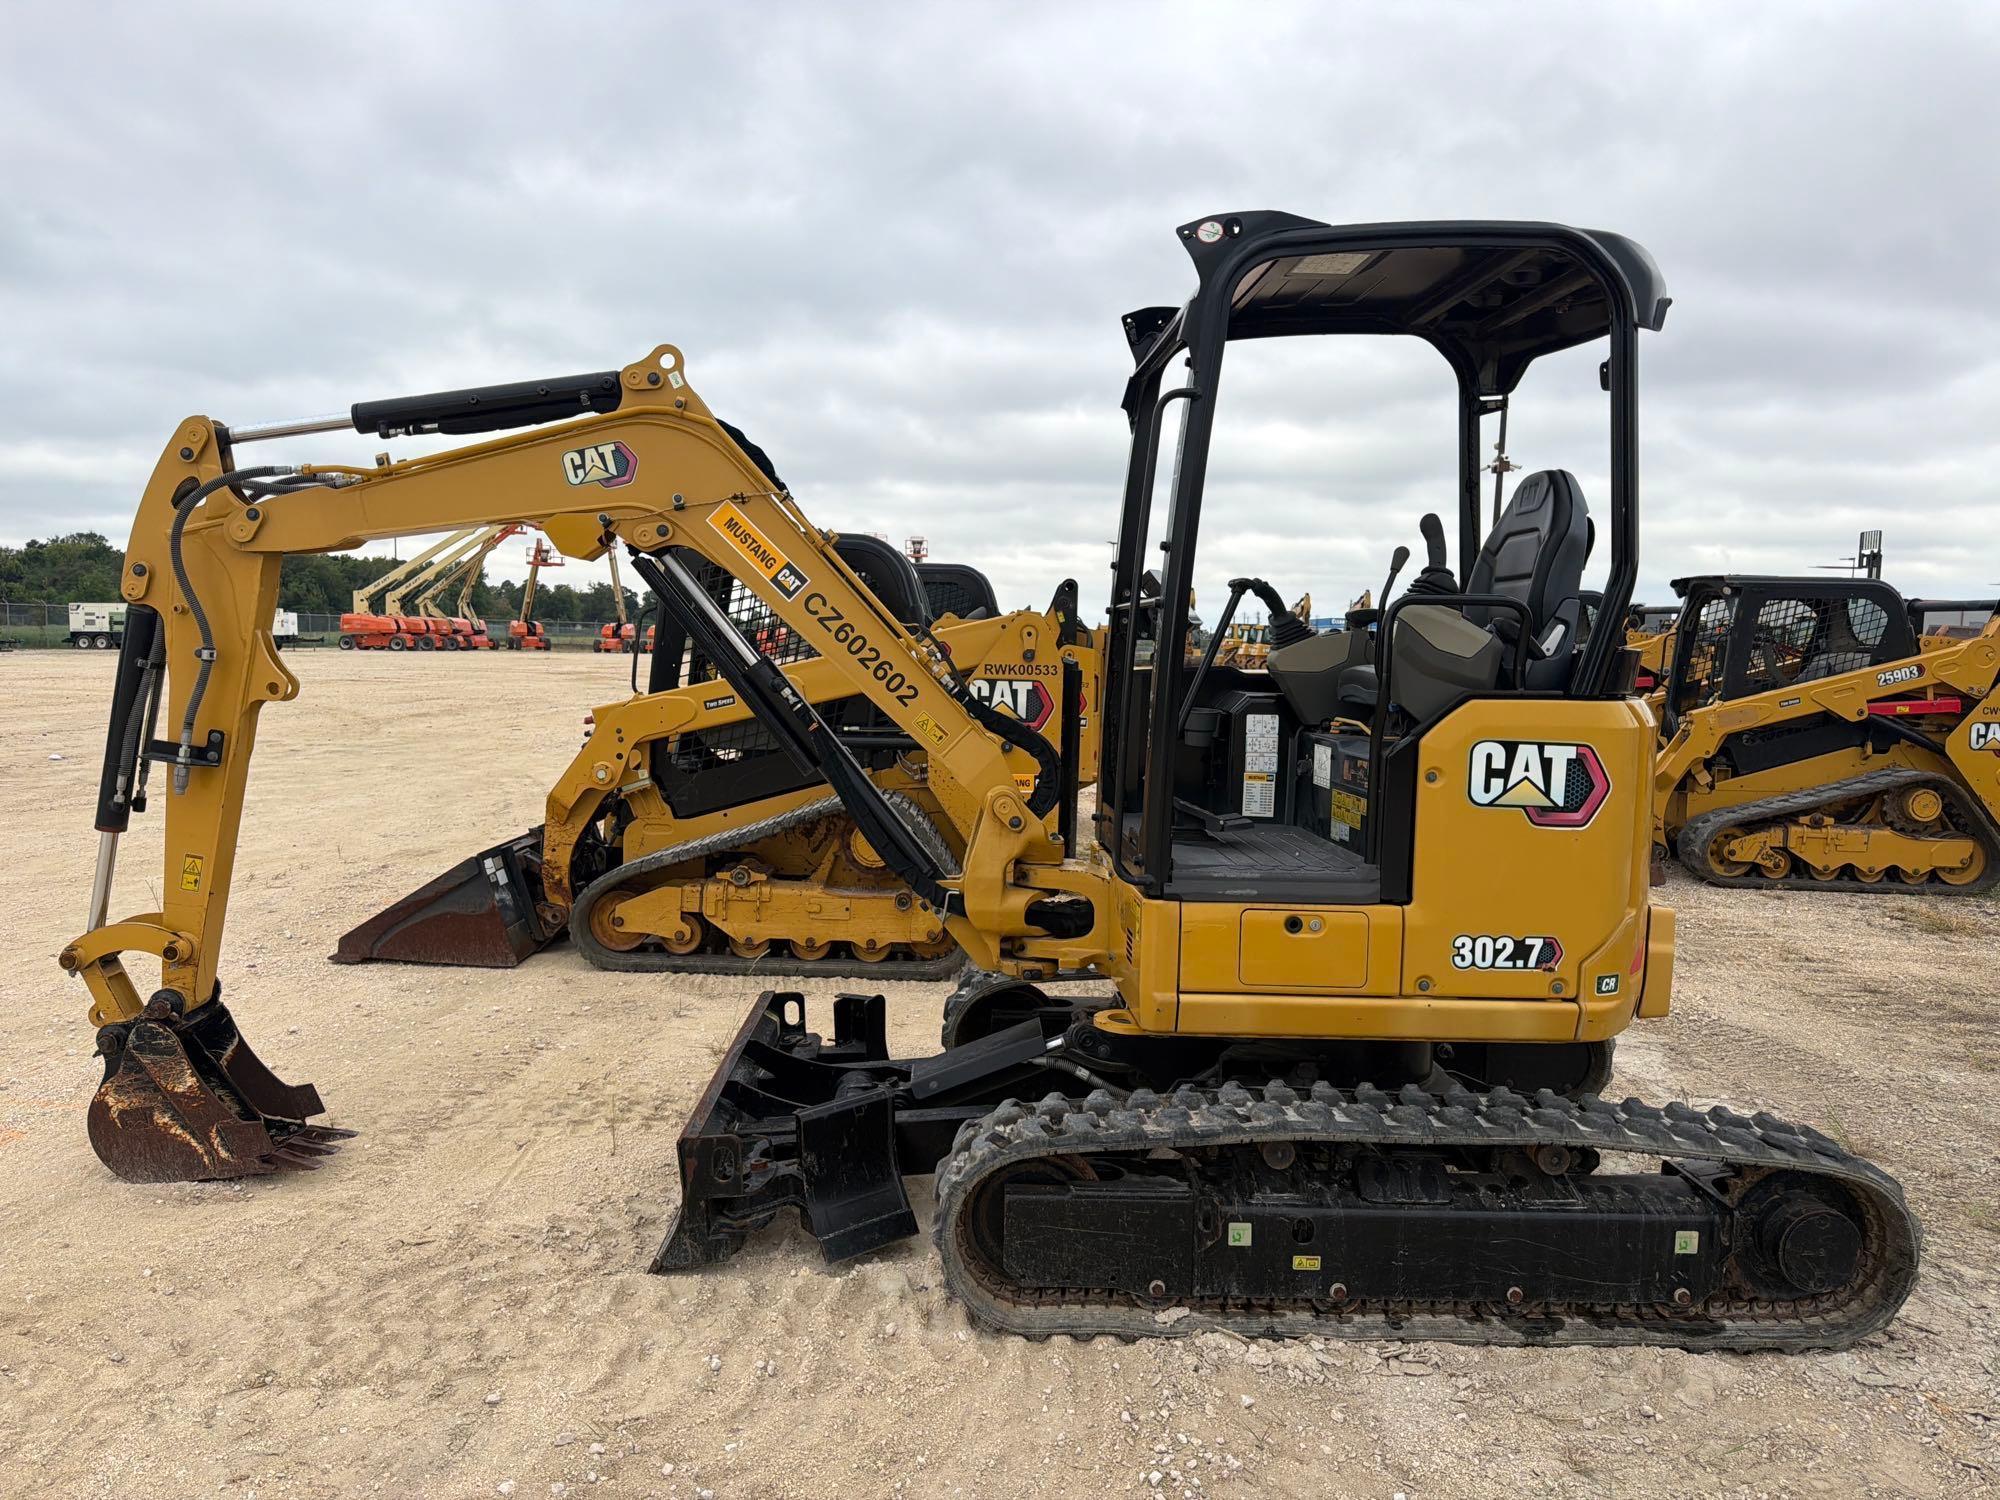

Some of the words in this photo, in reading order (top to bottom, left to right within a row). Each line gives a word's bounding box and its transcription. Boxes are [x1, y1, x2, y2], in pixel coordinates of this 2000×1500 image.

[563, 443, 618, 485] CAT
[723, 516, 777, 570] MUSTANG
[777, 568, 801, 592] CAT
[803, 592, 919, 708] CZ602602
[984, 663, 1058, 676] RWK00533
[1877, 665, 1918, 686] 259D3
[969, 679, 1033, 720] CAT
[1470, 741, 1576, 807] CAT
[1453, 936, 1544, 969] 302.7
[1601, 977, 1616, 992] CR
